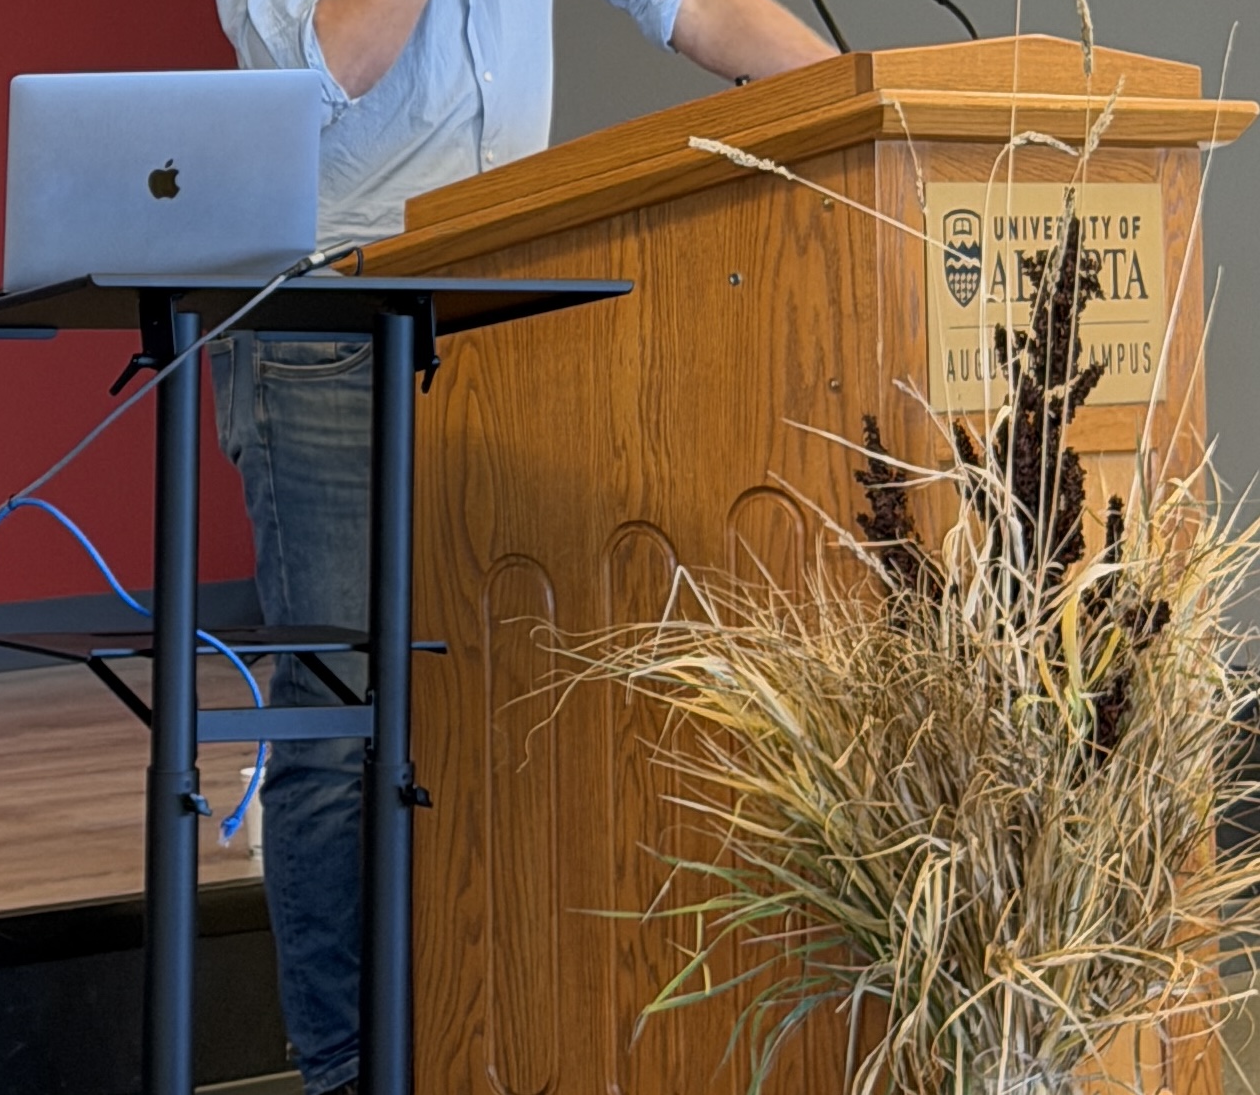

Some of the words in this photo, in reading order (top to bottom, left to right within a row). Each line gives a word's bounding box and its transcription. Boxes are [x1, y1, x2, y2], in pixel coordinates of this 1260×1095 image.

[993, 215, 1112, 241] UNIVEITY
[1119, 215, 1141, 240] OF
[1076, 341, 1152, 378] AMPUS
